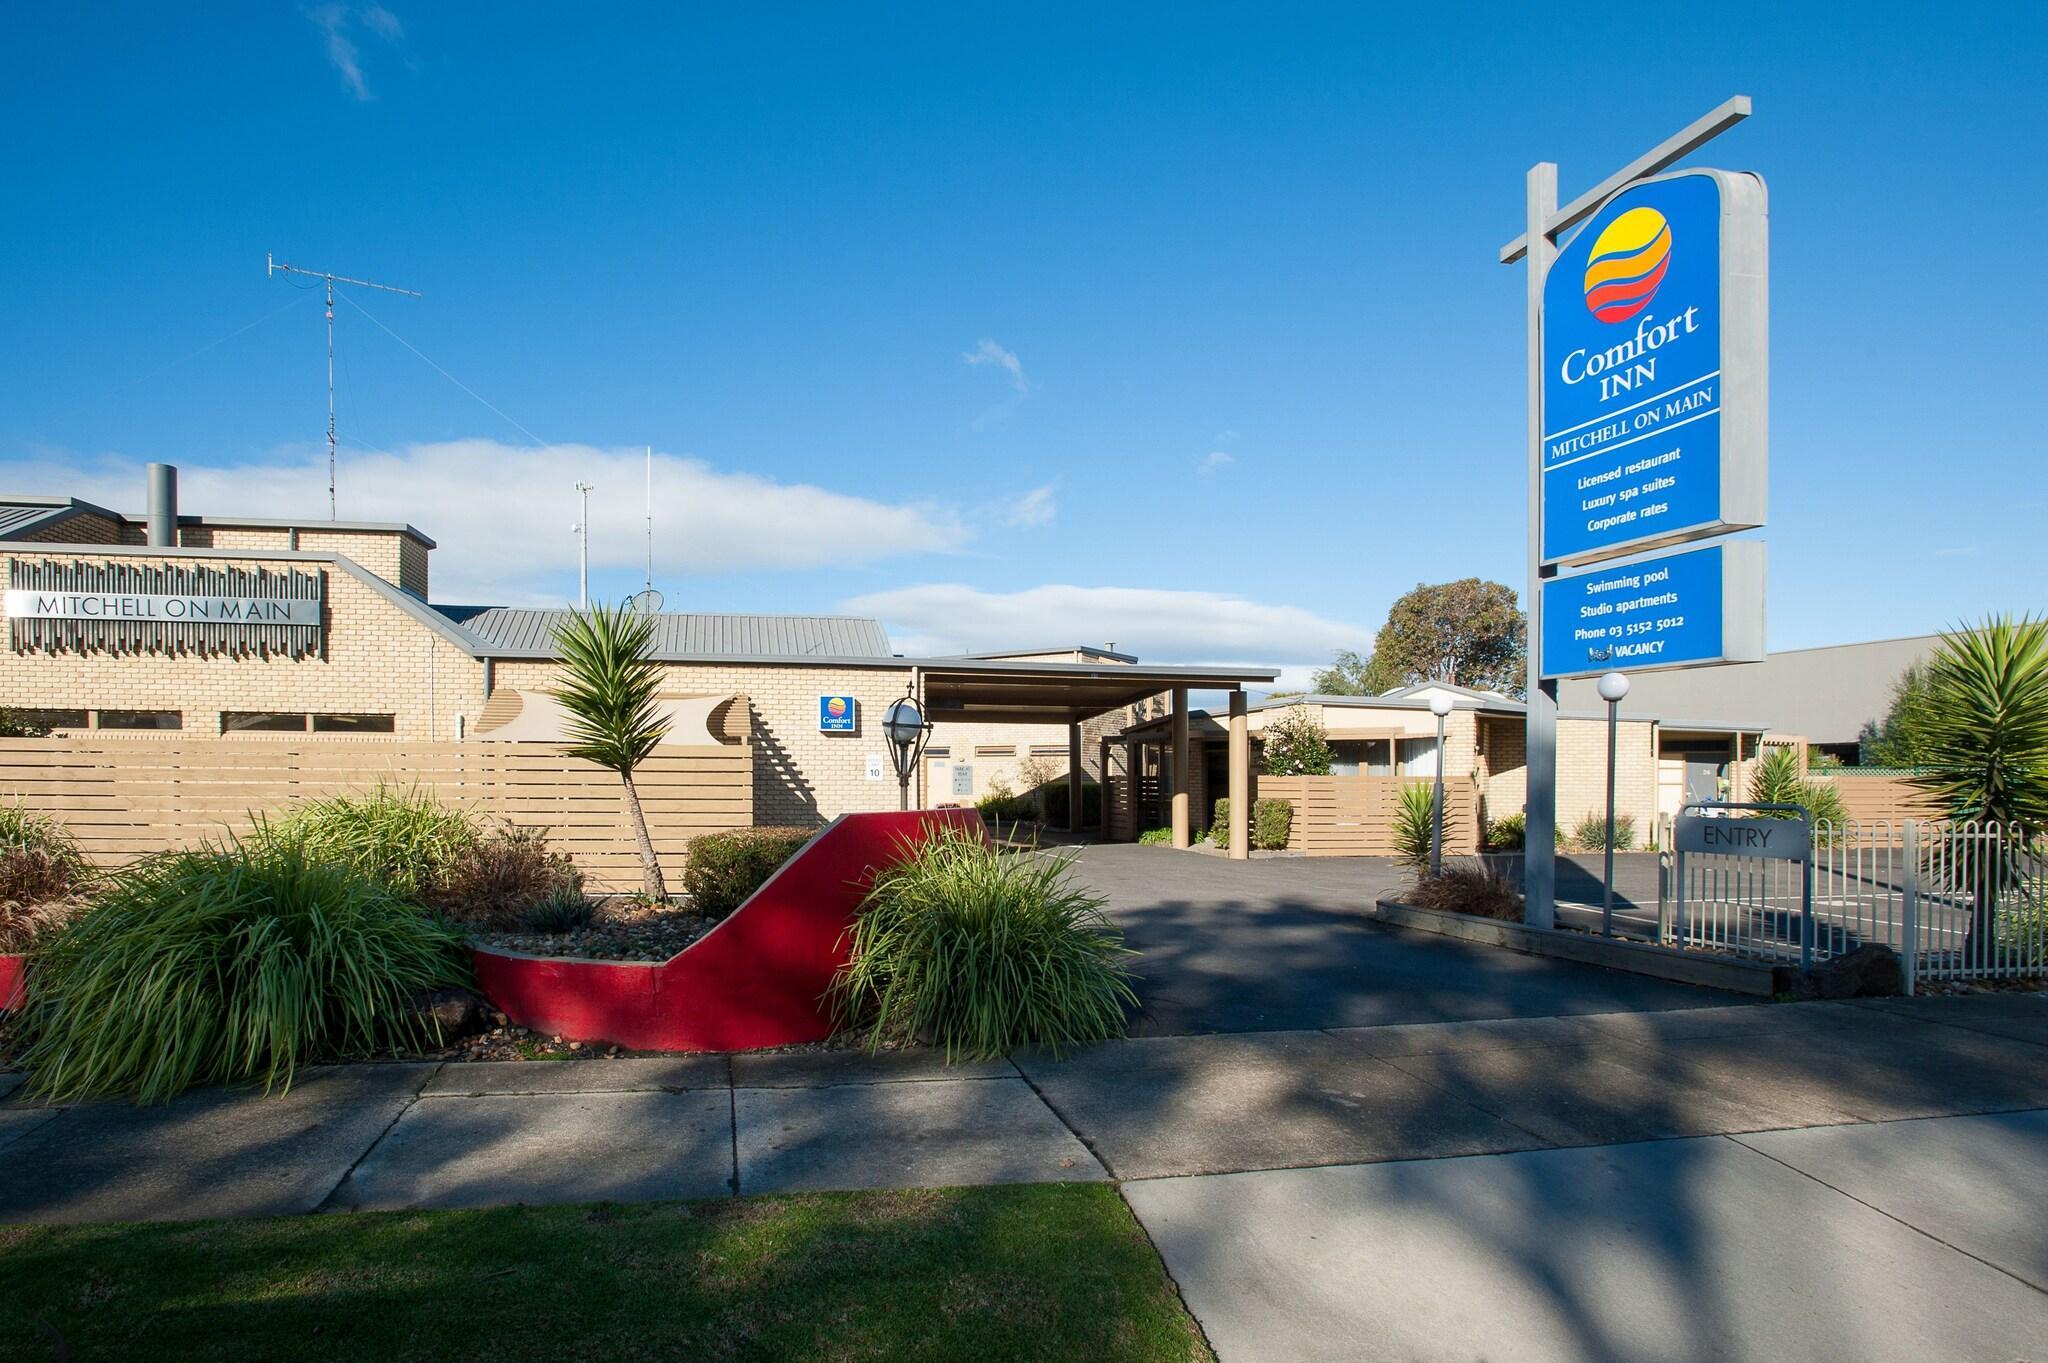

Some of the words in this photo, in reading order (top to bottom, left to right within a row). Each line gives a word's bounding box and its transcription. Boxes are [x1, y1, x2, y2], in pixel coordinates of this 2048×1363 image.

[1561, 305, 1699, 385] Comfort
[1600, 358, 1656, 402] INN
[1551, 420, 1631, 459] MITCHELL
[1634, 407, 1660, 429] ON
[1664, 386, 1713, 420] MAIN
[1577, 466, 1622, 490] Licensed
[1625, 447, 1681, 475] restaurant
[1582, 493, 1616, 511] Luxury
[1619, 487, 1639, 502] spa
[1642, 474, 1676, 493] suites
[1587, 511, 1637, 532] Corporate
[1640, 501, 1668, 518] rates
[1586, 574, 1640, 595] Swimming
[1643, 567, 1669, 586] pool
[37, 596, 157, 617] MITCHELL
[165, 599, 208, 618] ON
[220, 600, 292, 621] MAIN
[1580, 603, 1613, 618] Studio
[1616, 591, 1678, 614] apartments
[1574, 627, 1606, 641] Phone
[1609, 625, 1622, 637] 03
[1626, 621, 1652, 636] 5152
[1656, 616, 1684, 632] 5012
[1615, 640, 1664, 658] VACANCY
[823, 716, 851, 724] Comfort
[1703, 825, 1773, 848] ENTRY
